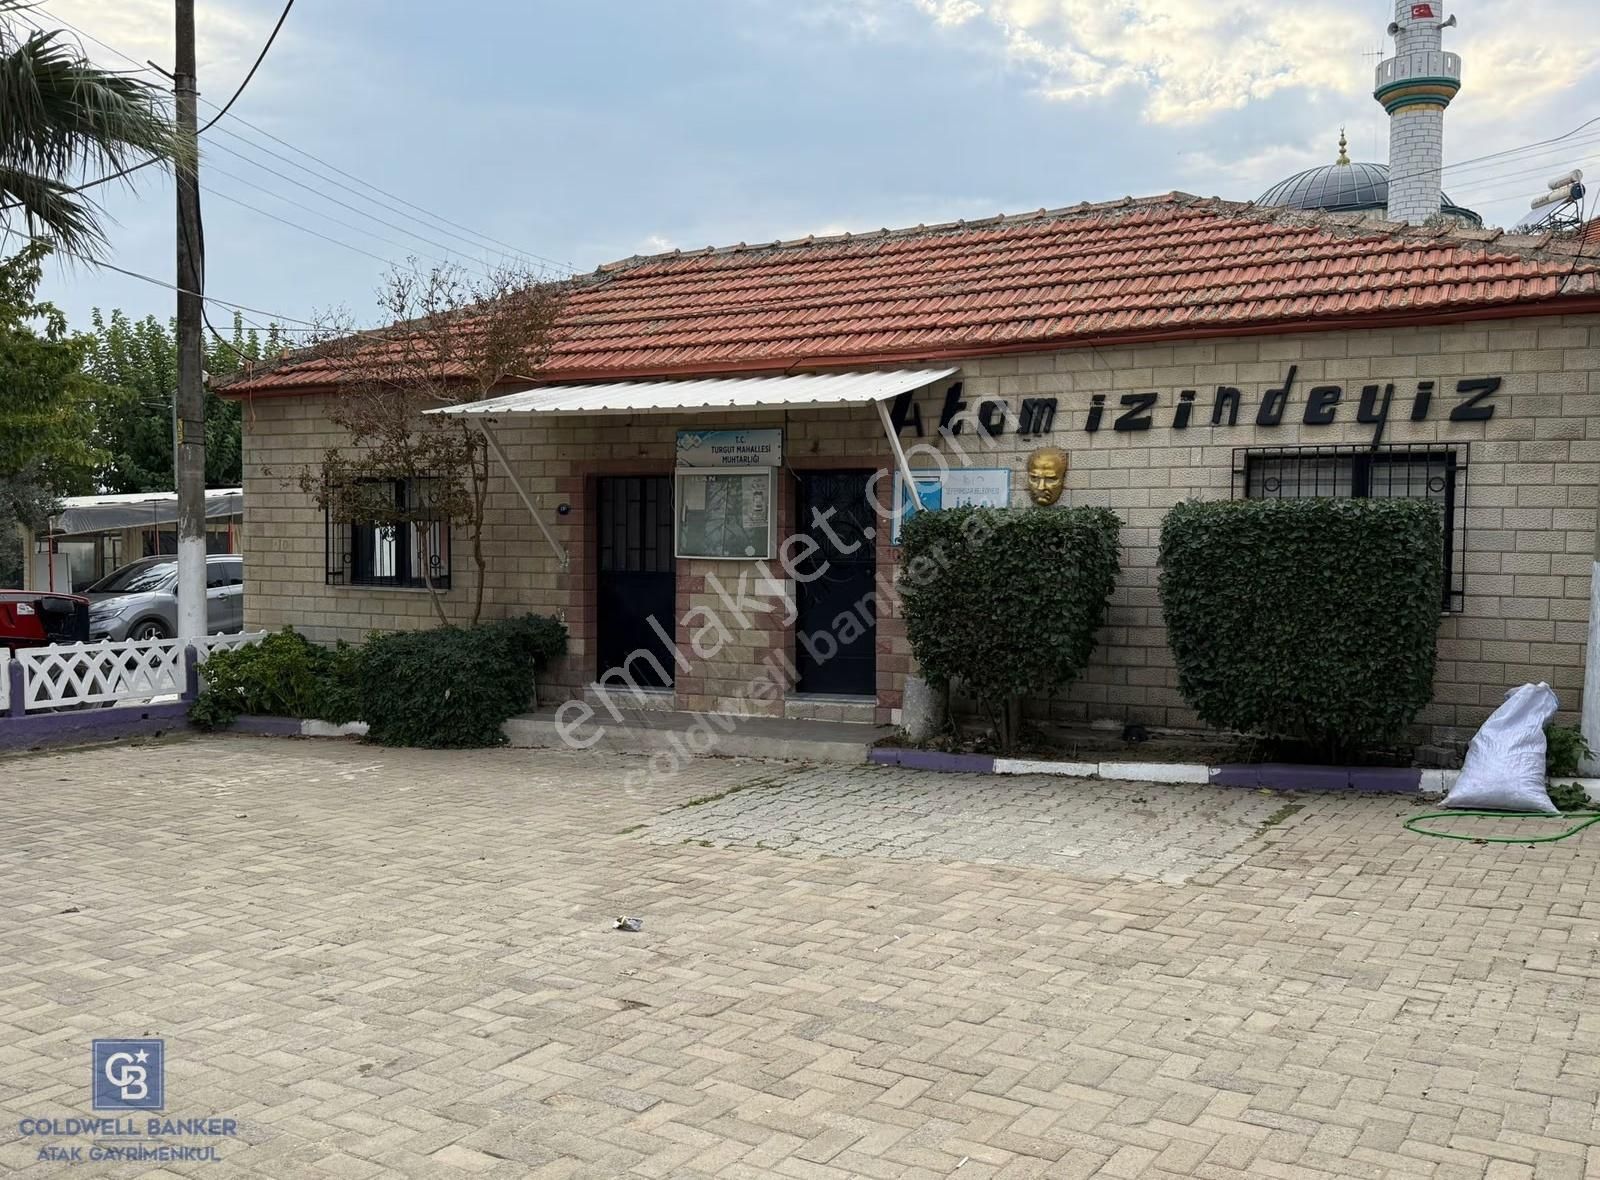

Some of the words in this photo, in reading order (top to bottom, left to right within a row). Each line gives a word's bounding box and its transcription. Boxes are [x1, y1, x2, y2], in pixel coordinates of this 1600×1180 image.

[1085, 364, 1502, 450] izindeyiz
[711, 446, 735, 454] TURGUT
[736, 444, 771, 454] MAHALLESİ
[721, 454, 760, 463] MUHTARLIĞI
